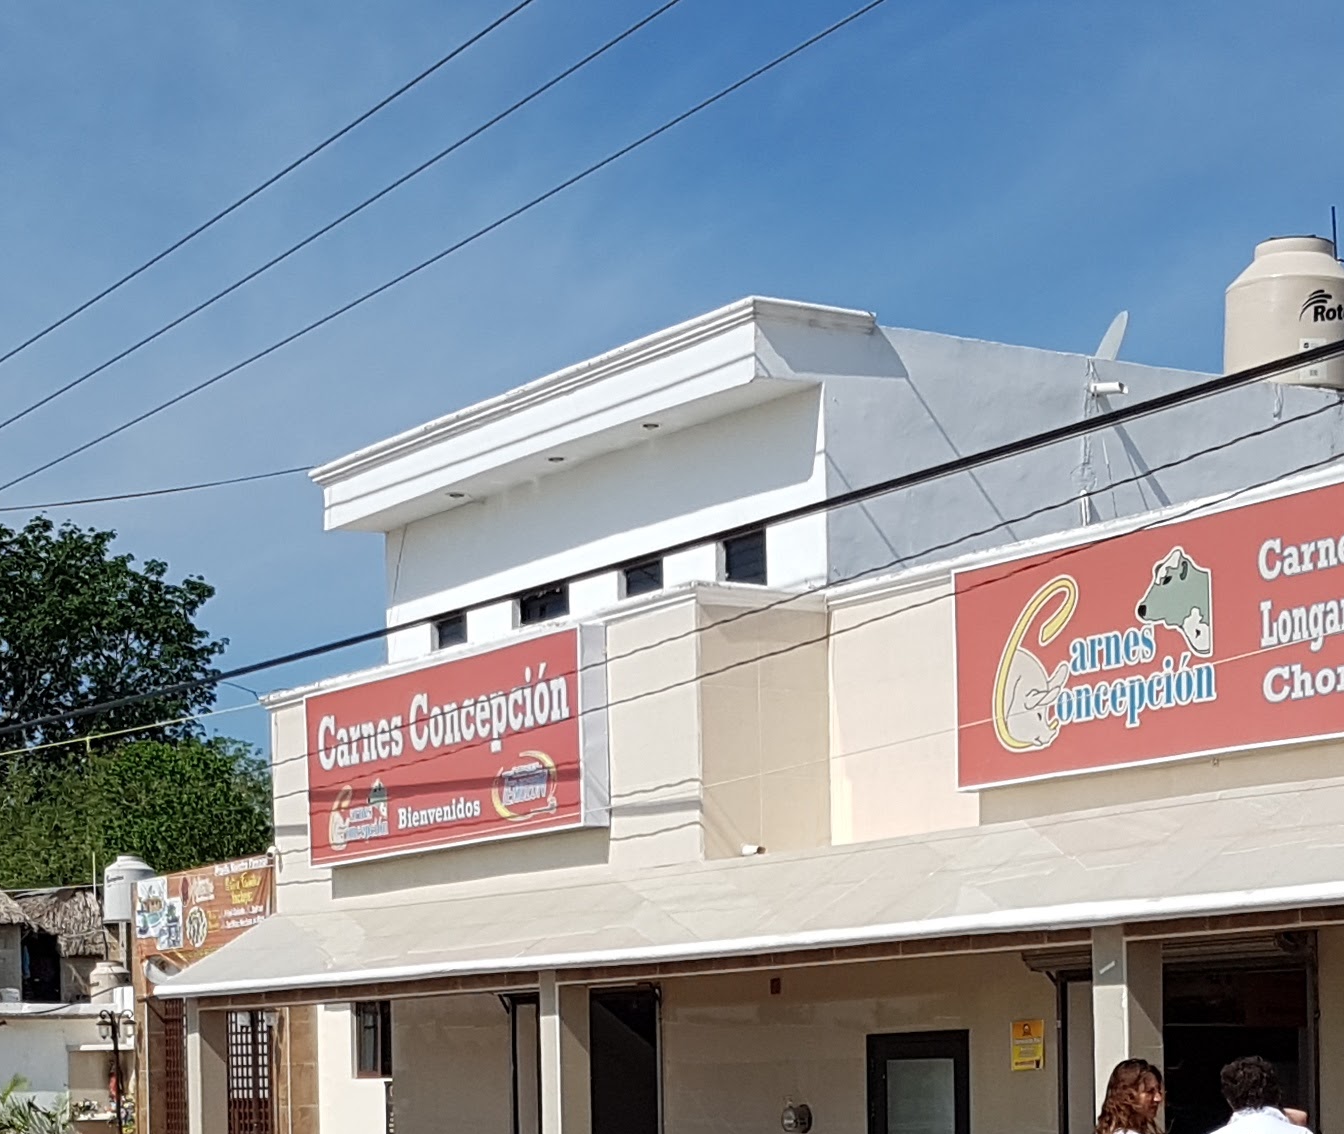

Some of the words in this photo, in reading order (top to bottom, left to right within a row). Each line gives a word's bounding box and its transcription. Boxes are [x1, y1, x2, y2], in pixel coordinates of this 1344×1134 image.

[317, 712, 403, 772] Carnes
[409, 662, 570, 752] Concepción
[398, 797, 481, 829] Bienvenidos
